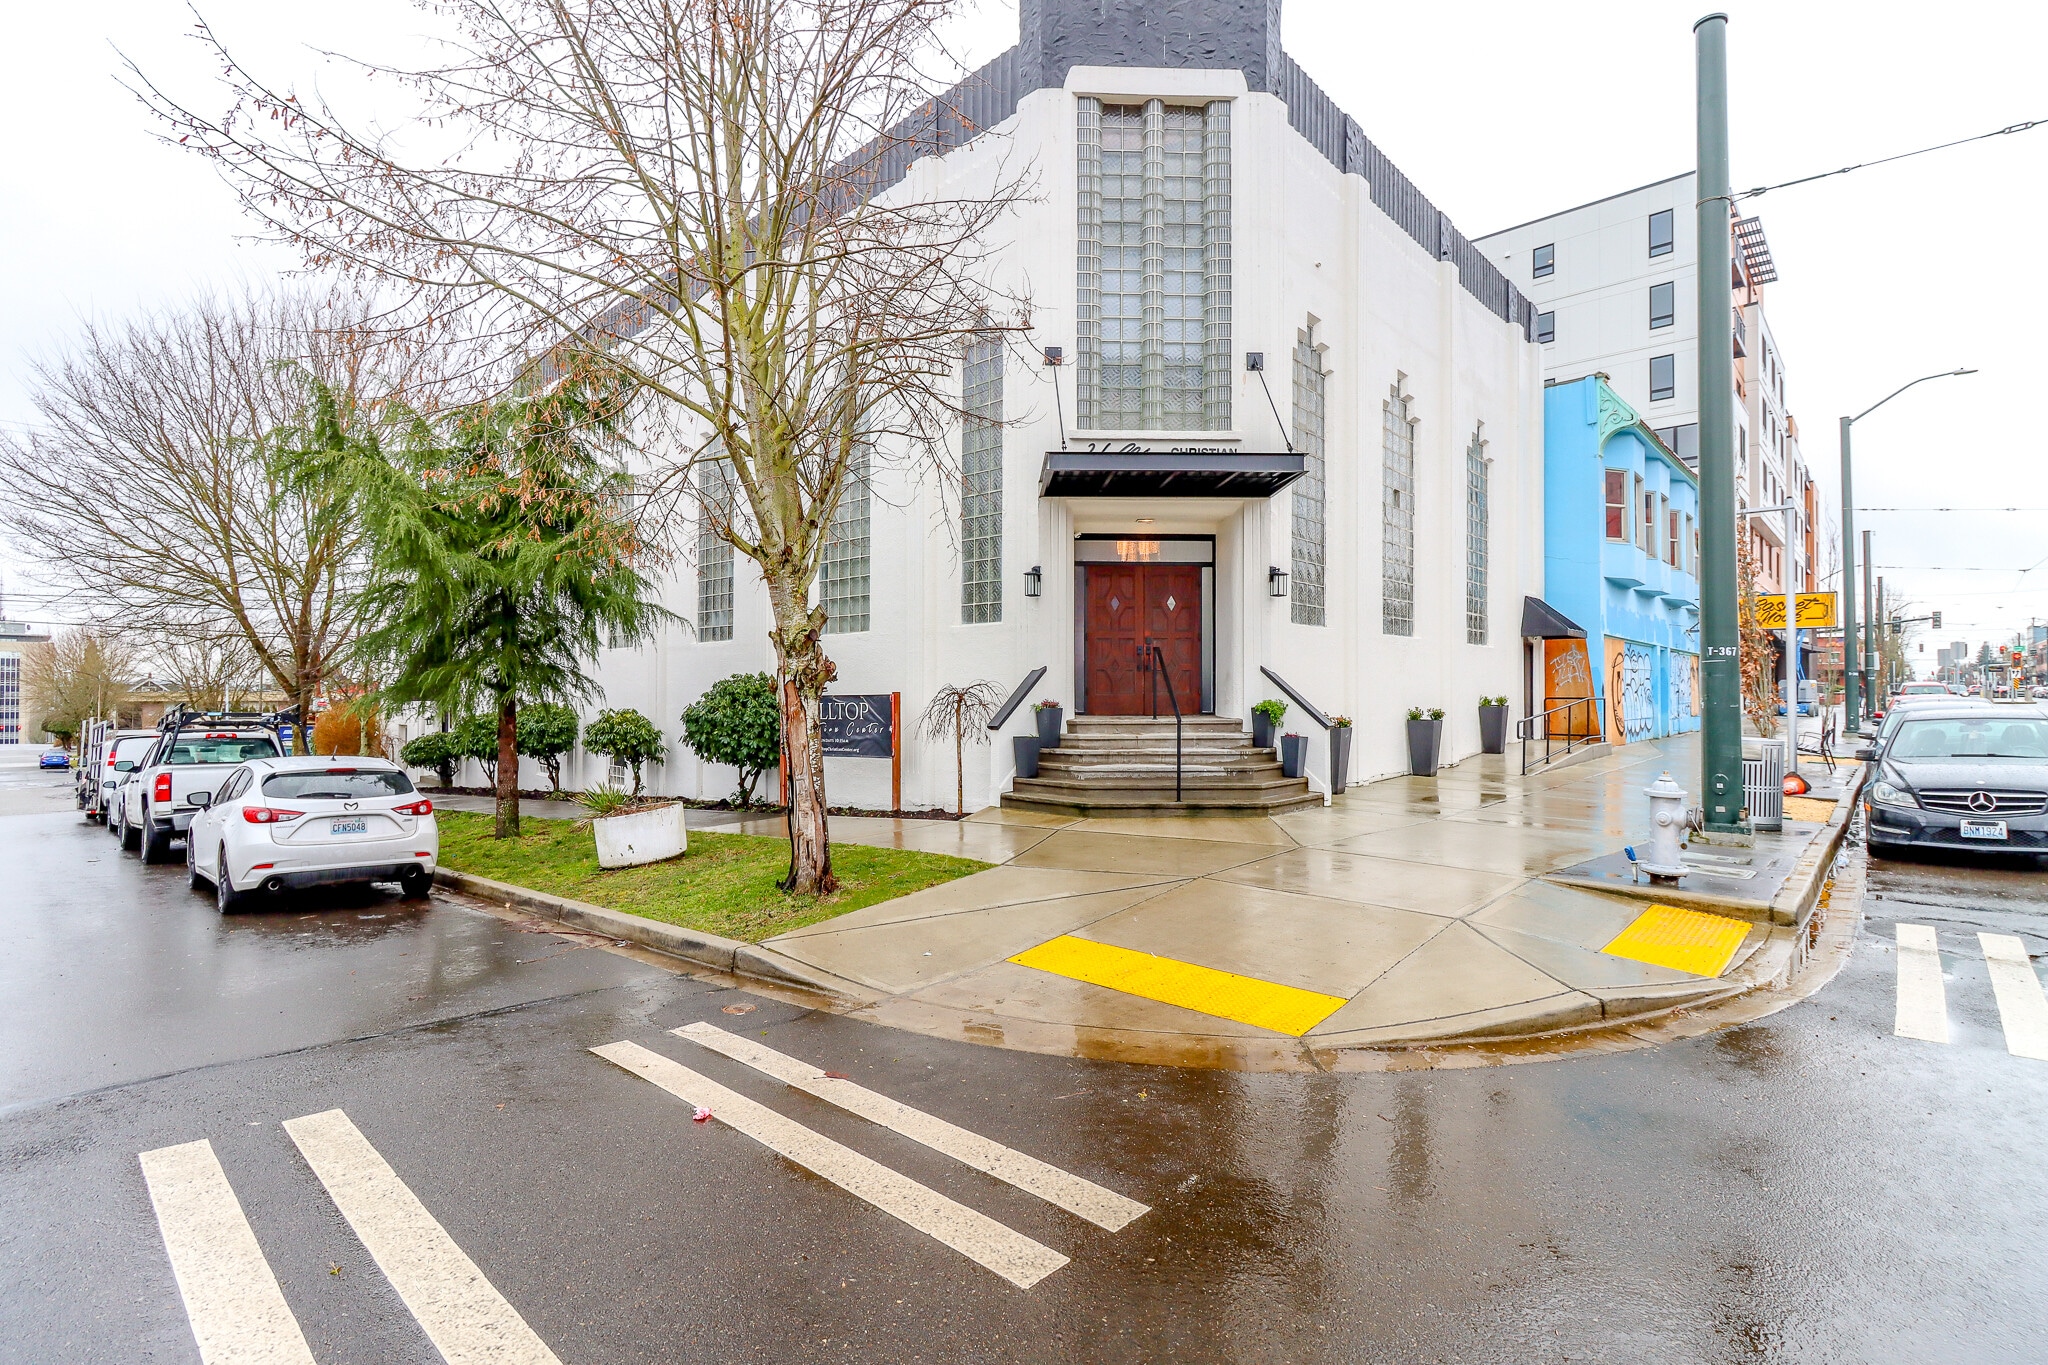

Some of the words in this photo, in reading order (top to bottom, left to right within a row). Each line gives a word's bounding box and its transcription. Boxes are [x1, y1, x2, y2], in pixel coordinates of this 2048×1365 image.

[1755, 597, 1820, 612] Baset
[1707, 646, 1737, 657] T-367
[819, 702, 869, 721] LLTOP
[332, 822, 366, 833] CFN5048
